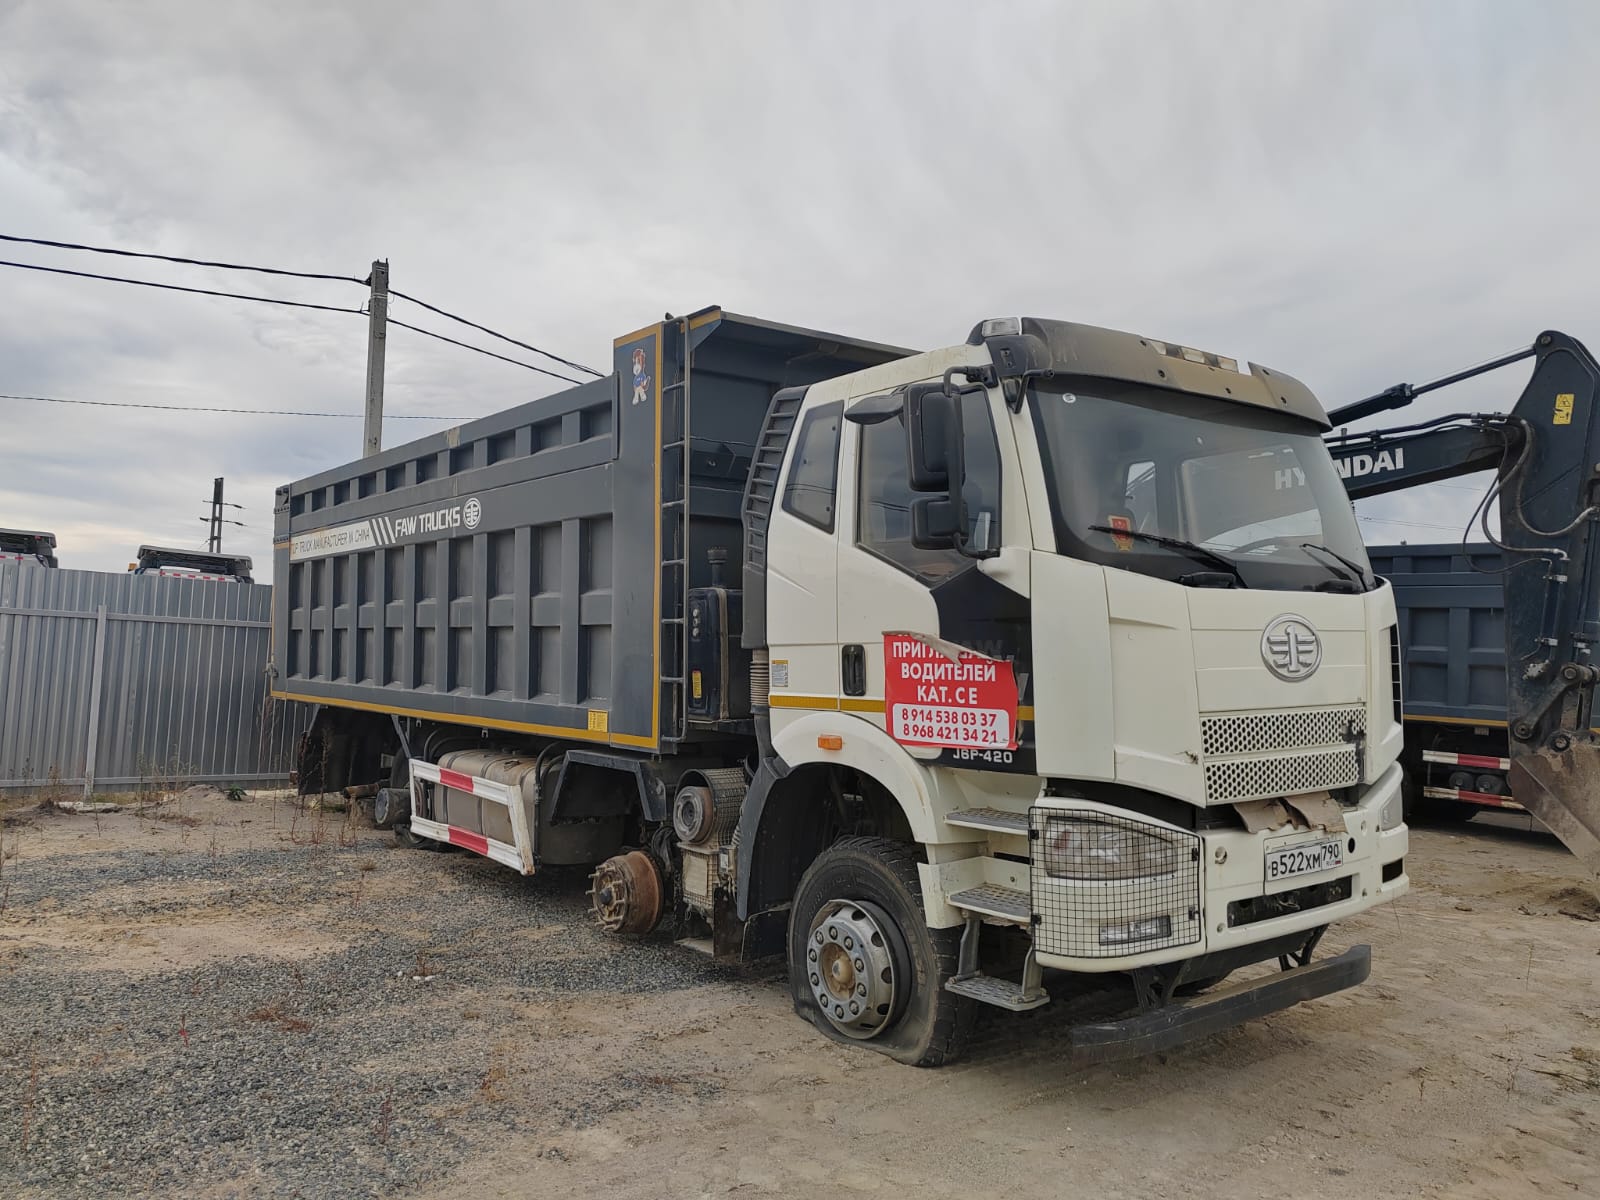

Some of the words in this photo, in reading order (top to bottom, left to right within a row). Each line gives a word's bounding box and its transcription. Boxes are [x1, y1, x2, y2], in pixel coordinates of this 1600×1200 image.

[1274, 448, 1404, 490] HYNDAI
[394, 516, 418, 538] FAW
[418, 507, 461, 532] TRUCKS
[901, 660, 996, 683] ВОДИТЕЛЕЙ
[911, 708, 933, 723] 914
[935, 710, 959, 724] 538
[961, 712, 977, 726] 03
[980, 713, 997, 727] 37
[912, 724, 934, 739] 968
[936, 726, 959, 740] 421
[962, 728, 978, 742] 34
[981, 729, 997, 743] 21
[952, 748, 1013, 764] J6P-420
